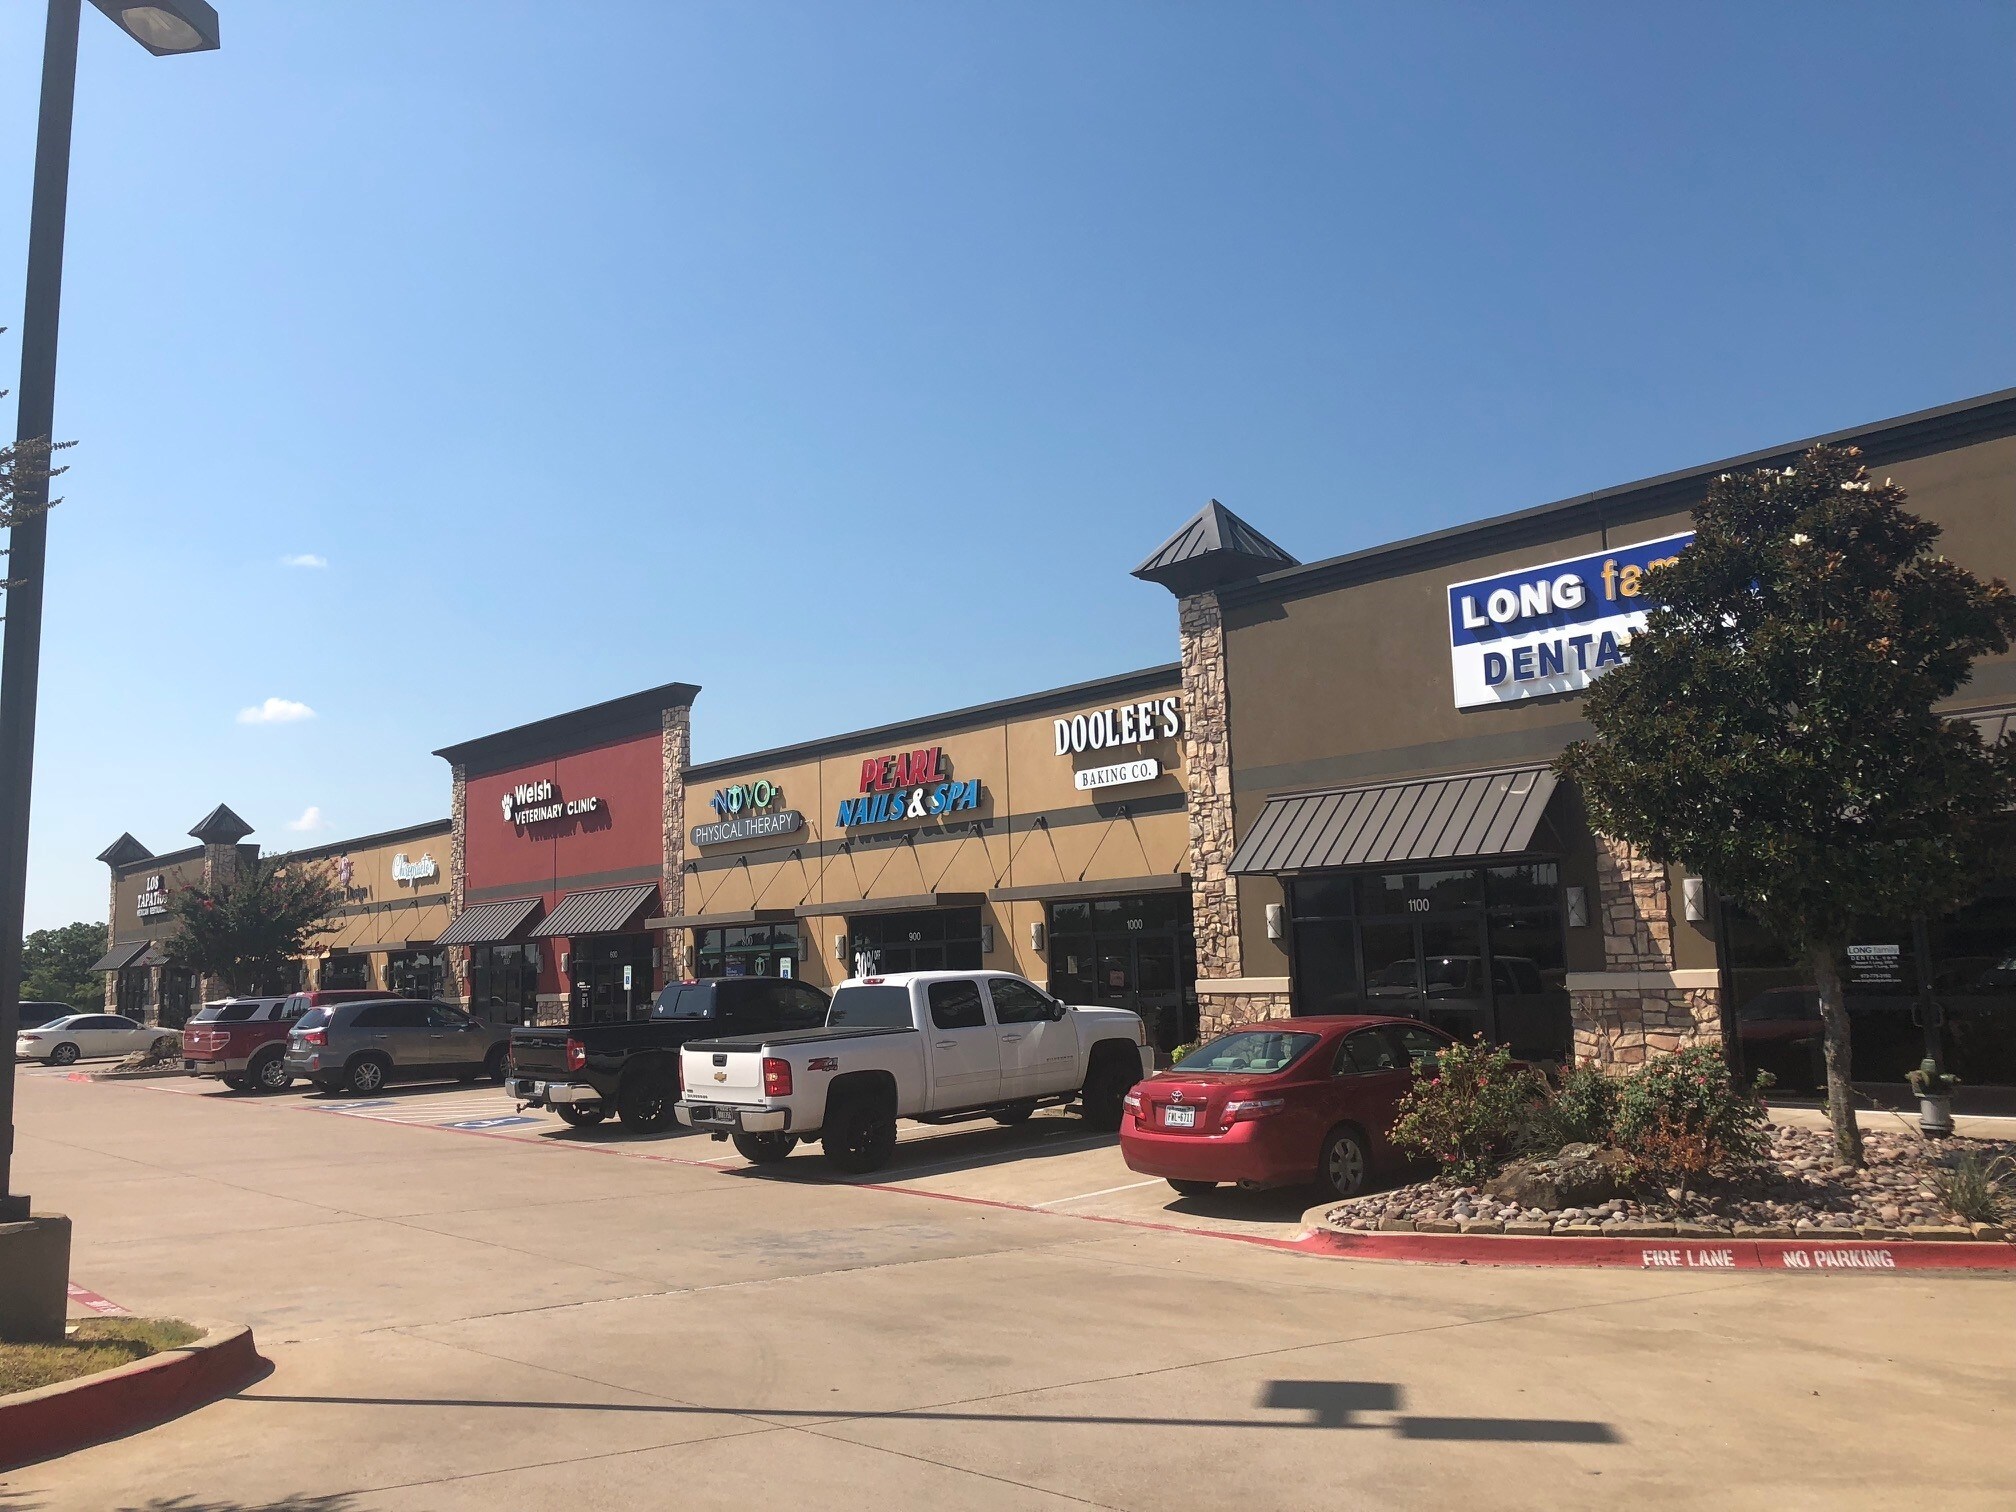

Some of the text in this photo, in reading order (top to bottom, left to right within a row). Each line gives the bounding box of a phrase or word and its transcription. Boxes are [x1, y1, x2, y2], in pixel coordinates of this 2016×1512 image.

[1461, 573, 1586, 630] LONG
[1484, 627, 1646, 686] DENTA
[1053, 697, 1180, 757] DOOLEE'S
[859, 746, 946, 794] PEARL
[1082, 763, 1152, 787] BAKING CO.
[514, 779, 552, 806] Welsh
[715, 780, 772, 815] NOVO
[835, 779, 982, 828] NAILS & SPA
[514, 796, 597, 825] VETERINARY CLINIC
[695, 812, 793, 844] PHYSICAL THERAPY
[146, 875, 159, 891] LOS
[1407, 898, 1430, 912] 1100
[908, 931, 921, 942] 900
[1126, 919, 1143, 930] 1000
[855, 950, 877, 979] 30%
[1849, 946, 1873, 954] LONG
[1642, 1249, 1896, 1268] FIRE LANE NO PARKING
